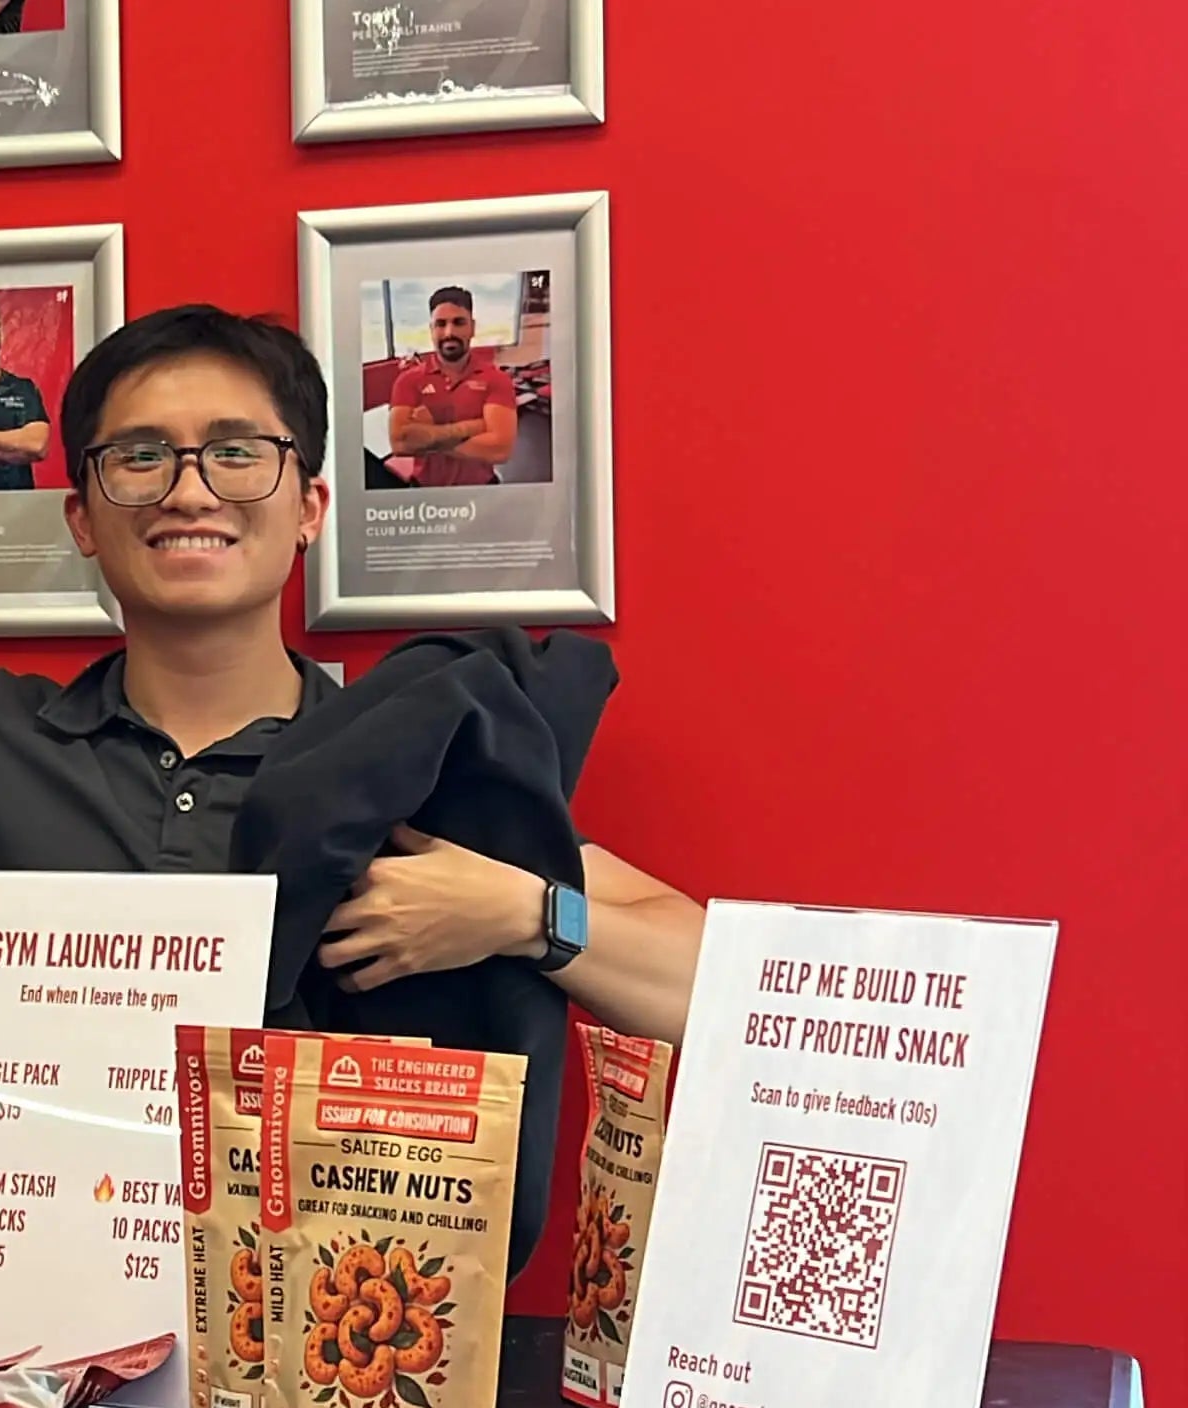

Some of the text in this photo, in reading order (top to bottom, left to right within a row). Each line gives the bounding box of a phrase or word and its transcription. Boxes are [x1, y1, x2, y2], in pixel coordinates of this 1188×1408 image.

[365, 501, 476, 523] David (Dave)
[365, 524, 457, 537] CLUB MANAGER
[45, 933, 143, 970] LAUNCH
[150, 935, 225, 973] PRICE
[20, 985, 178, 1012] End when I leave the gym
[759, 959, 967, 1009] HELP ME BUILD THE
[744, 1012, 970, 1069] BEST PROTEIN SNACK
[23, 1063, 61, 1086] PACK
[107, 1067, 168, 1092] TRIPPLE
[371, 1057, 476, 1079] THE ENGINEERED
[374, 1076, 467, 1097] SNACKS BRAND
[144, 1103, 173, 1126] $40
[751, 1081, 938, 1128] Scan to give feedback (30s)
[184, 1055, 206, 1200] Gnomnivore
[321, 1105, 472, 1135] ISSUED FOR CONSUMPTION
[266, 1066, 287, 1217] Gnomnivore
[341, 1138, 443, 1163] SALTED EGG
[11, 1173, 56, 1198] STASH
[122, 1180, 160, 1205] BEST
[311, 1163, 474, 1205] CASHEW NUTS
[298, 1198, 487, 1233] GREAT FOR SNACKING AND CHILLING!
[112, 1217, 181, 1244] 10 PACKS
[124, 1253, 160, 1280] $125
[192, 1227, 207, 1334] EXTREME HEAT
[269, 1244, 284, 1323] MILD HEAT
[667, 1345, 752, 1383] Reach out
